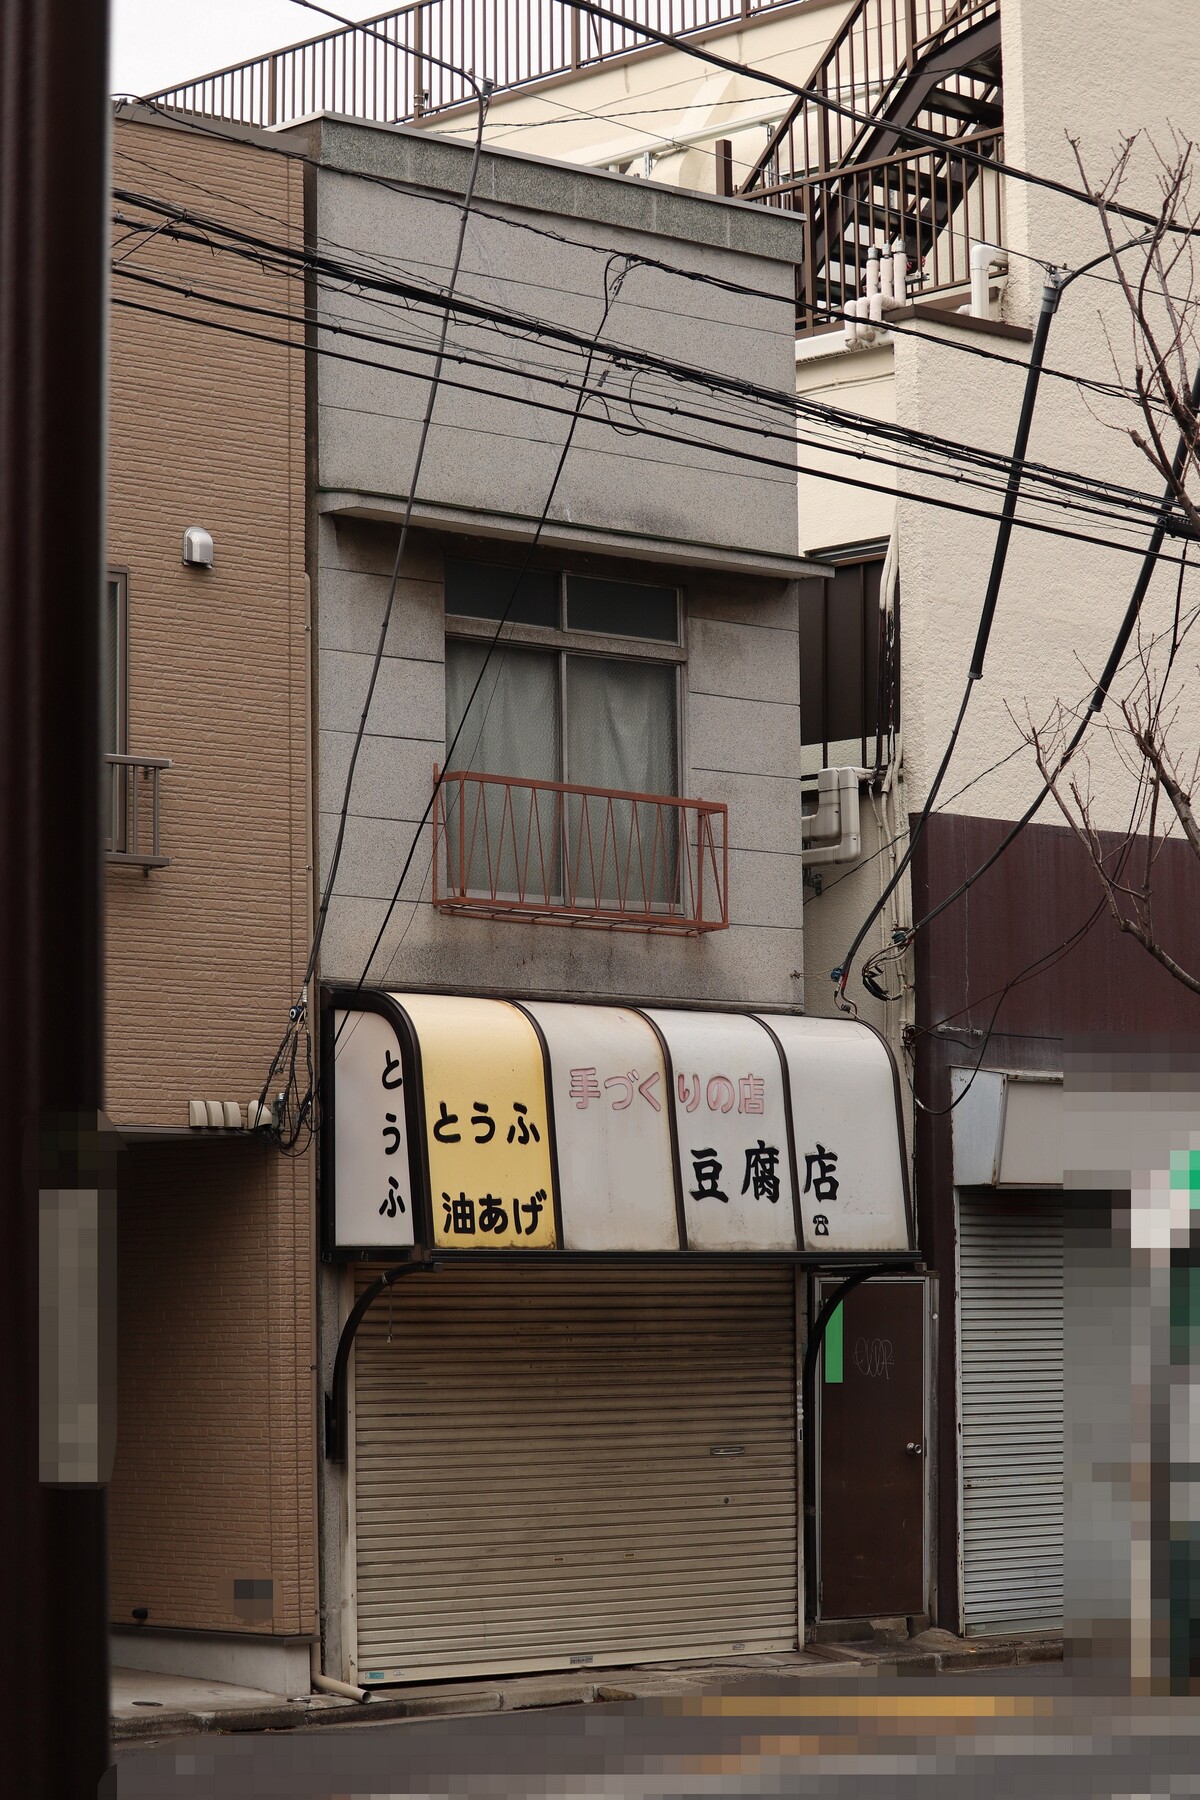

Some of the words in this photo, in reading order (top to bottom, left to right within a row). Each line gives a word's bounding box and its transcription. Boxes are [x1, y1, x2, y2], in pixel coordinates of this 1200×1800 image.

[569, 1067, 765, 1114] 手づくりの店
[379, 1050, 405, 1218] とうふ
[433, 1101, 541, 1145] とうふ
[689, 1139, 840, 1204] 豆腐店
[442, 1188, 547, 1236] 油あげ
